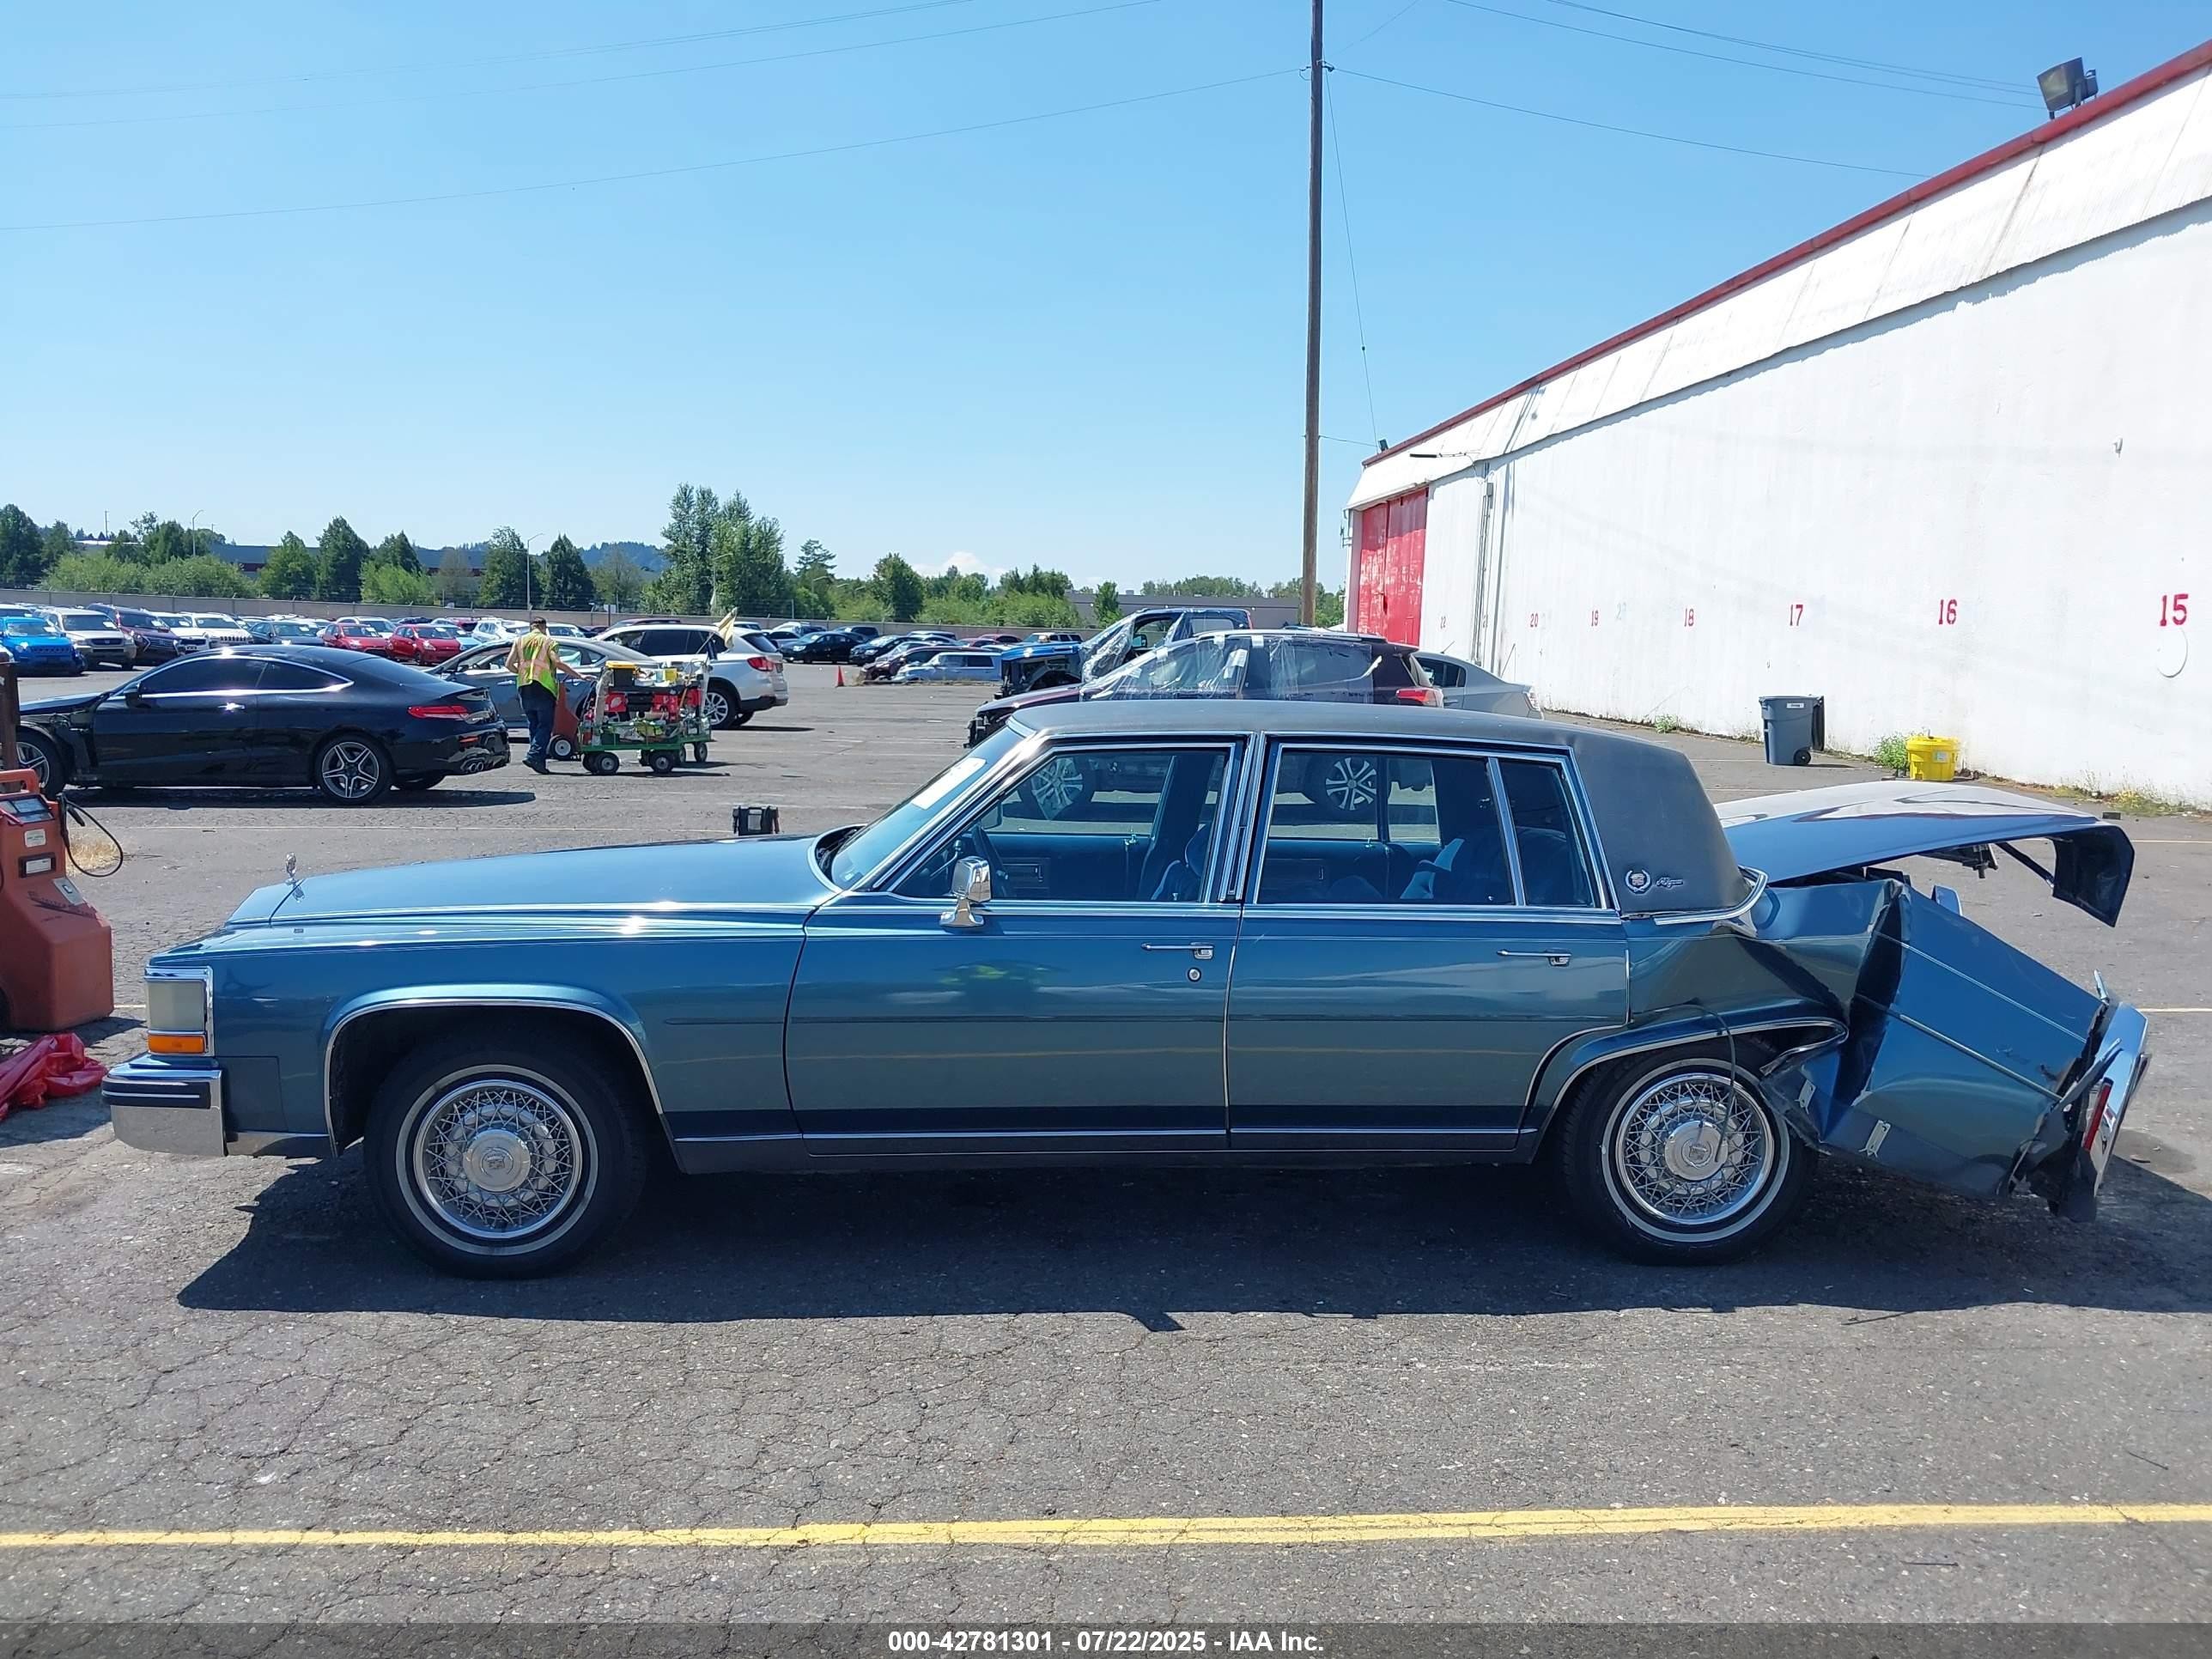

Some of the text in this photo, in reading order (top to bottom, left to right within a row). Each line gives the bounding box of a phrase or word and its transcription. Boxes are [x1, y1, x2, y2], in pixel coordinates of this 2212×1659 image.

[1529, 612, 1539, 628] 20
[1591, 610, 1599, 627] 19
[1684, 608, 1695, 627] 18
[1790, 604, 1804, 626] 17
[1938, 599, 1958, 625] 16
[2160, 593, 2189, 627] 15
